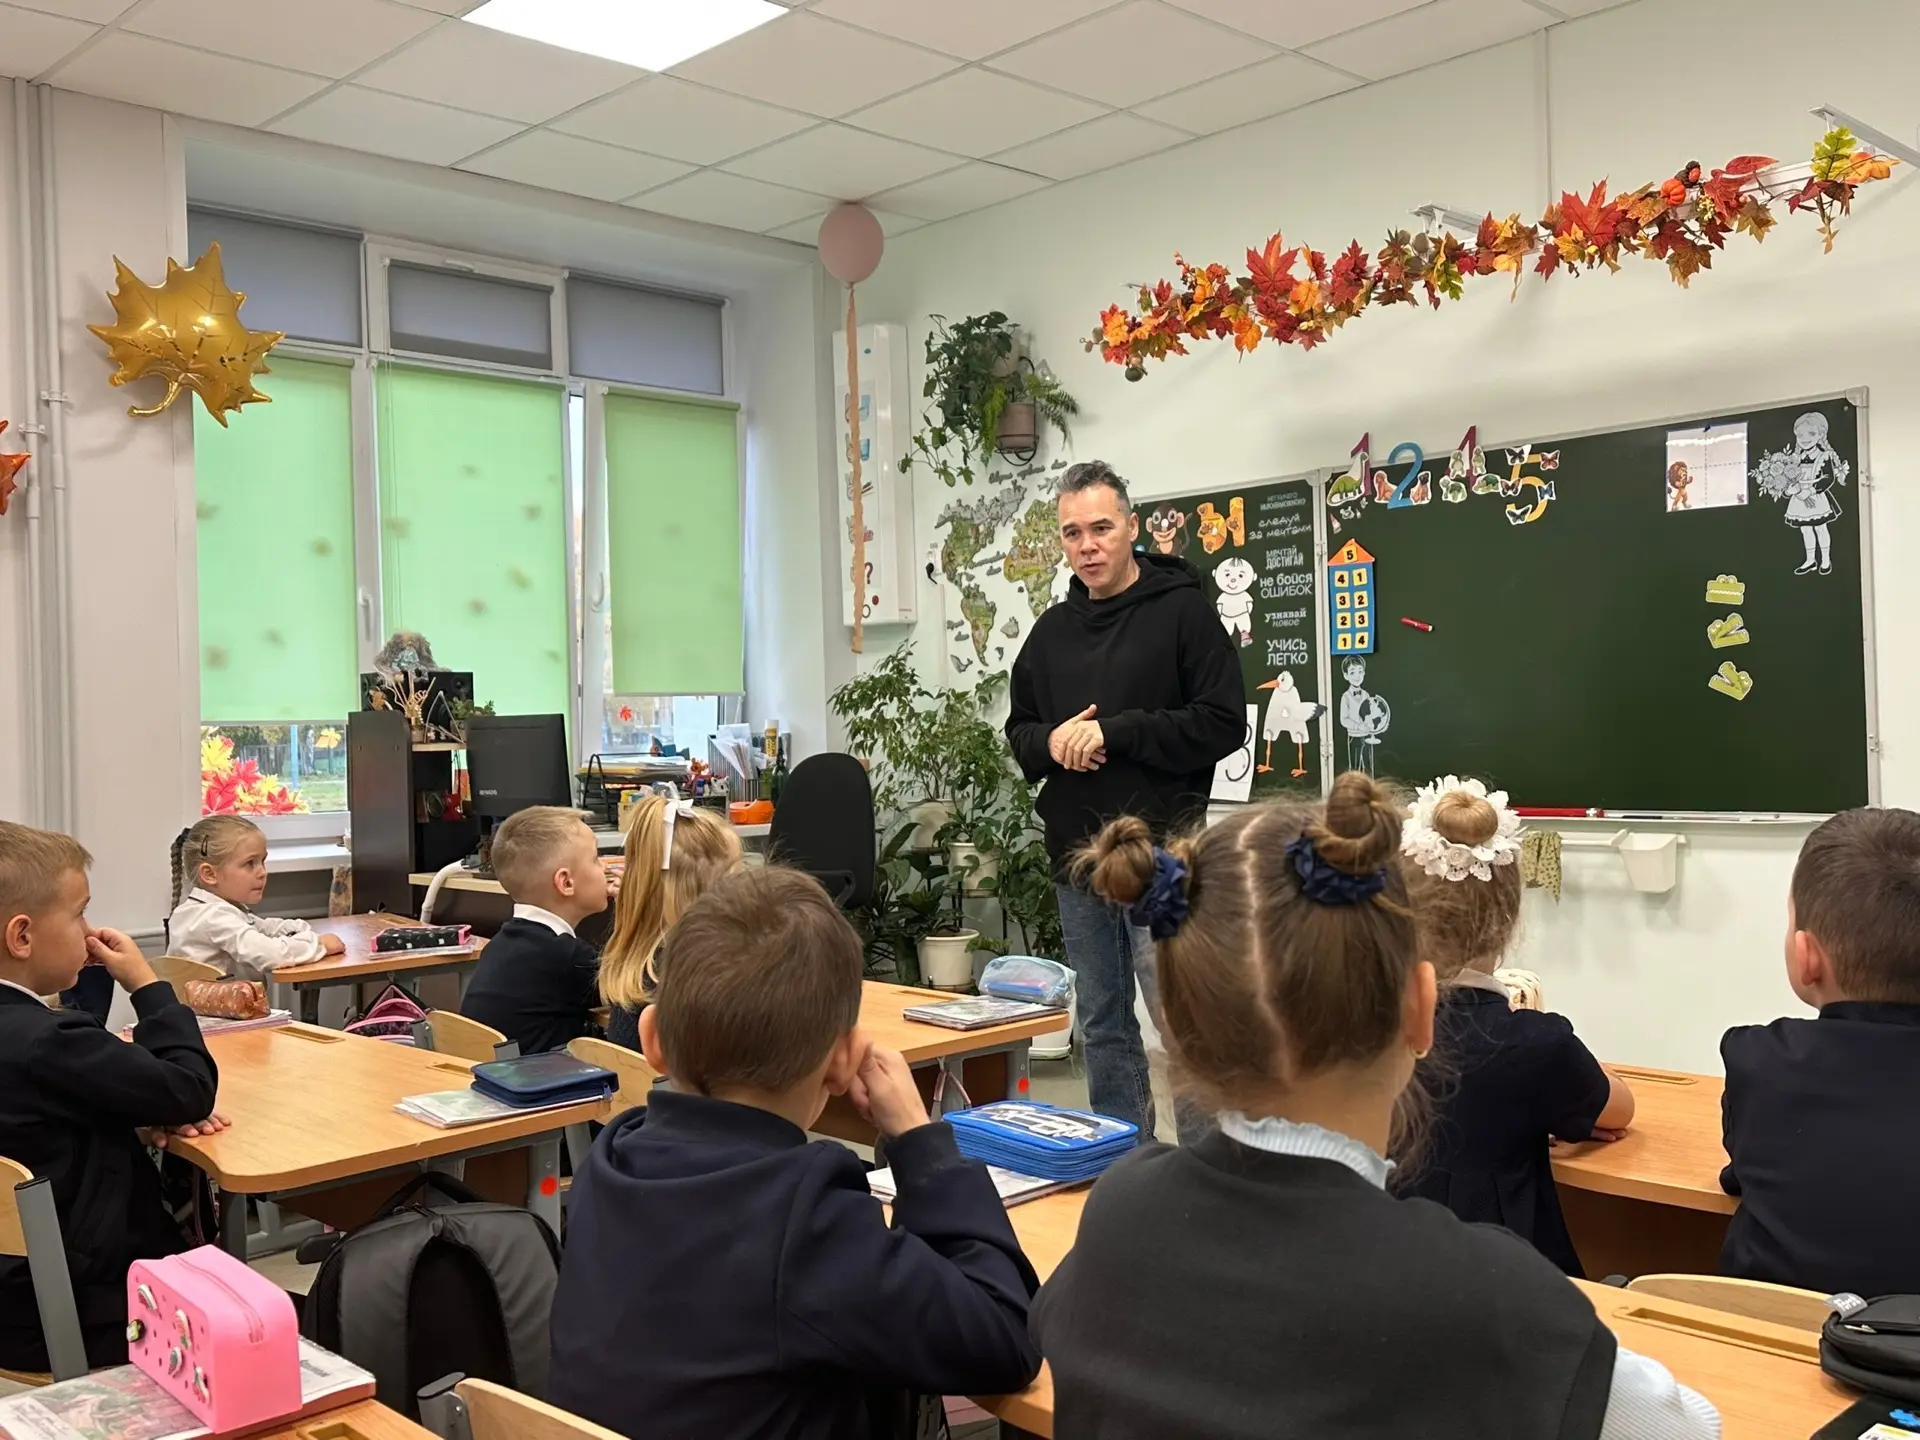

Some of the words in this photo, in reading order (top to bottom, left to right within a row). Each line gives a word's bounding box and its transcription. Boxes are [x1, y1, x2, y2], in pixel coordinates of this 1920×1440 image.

[1387, 441, 1425, 510] 2
[1266, 525, 1313, 539] мечтами
[1265, 552, 1304, 571] ДОСТИГАЙ
[1345, 549, 1354, 561] 5
[1259, 577, 1275, 588] не
[1276, 572, 1314, 585] бойся
[1337, 574, 1346, 584] 4
[1260, 584, 1313, 599] ОШИБОК
[1338, 595, 1347, 606] 3
[1357, 595, 1365, 605] 2
[1264, 607, 1307, 623] узнавай
[1340, 616, 1348, 626] 2
[1357, 614, 1366, 625] 3
[1266, 638, 1308, 652] УЧИСЬ
[1357, 635, 1366, 645] 4
[1266, 651, 1309, 667] ЛЕГКО
